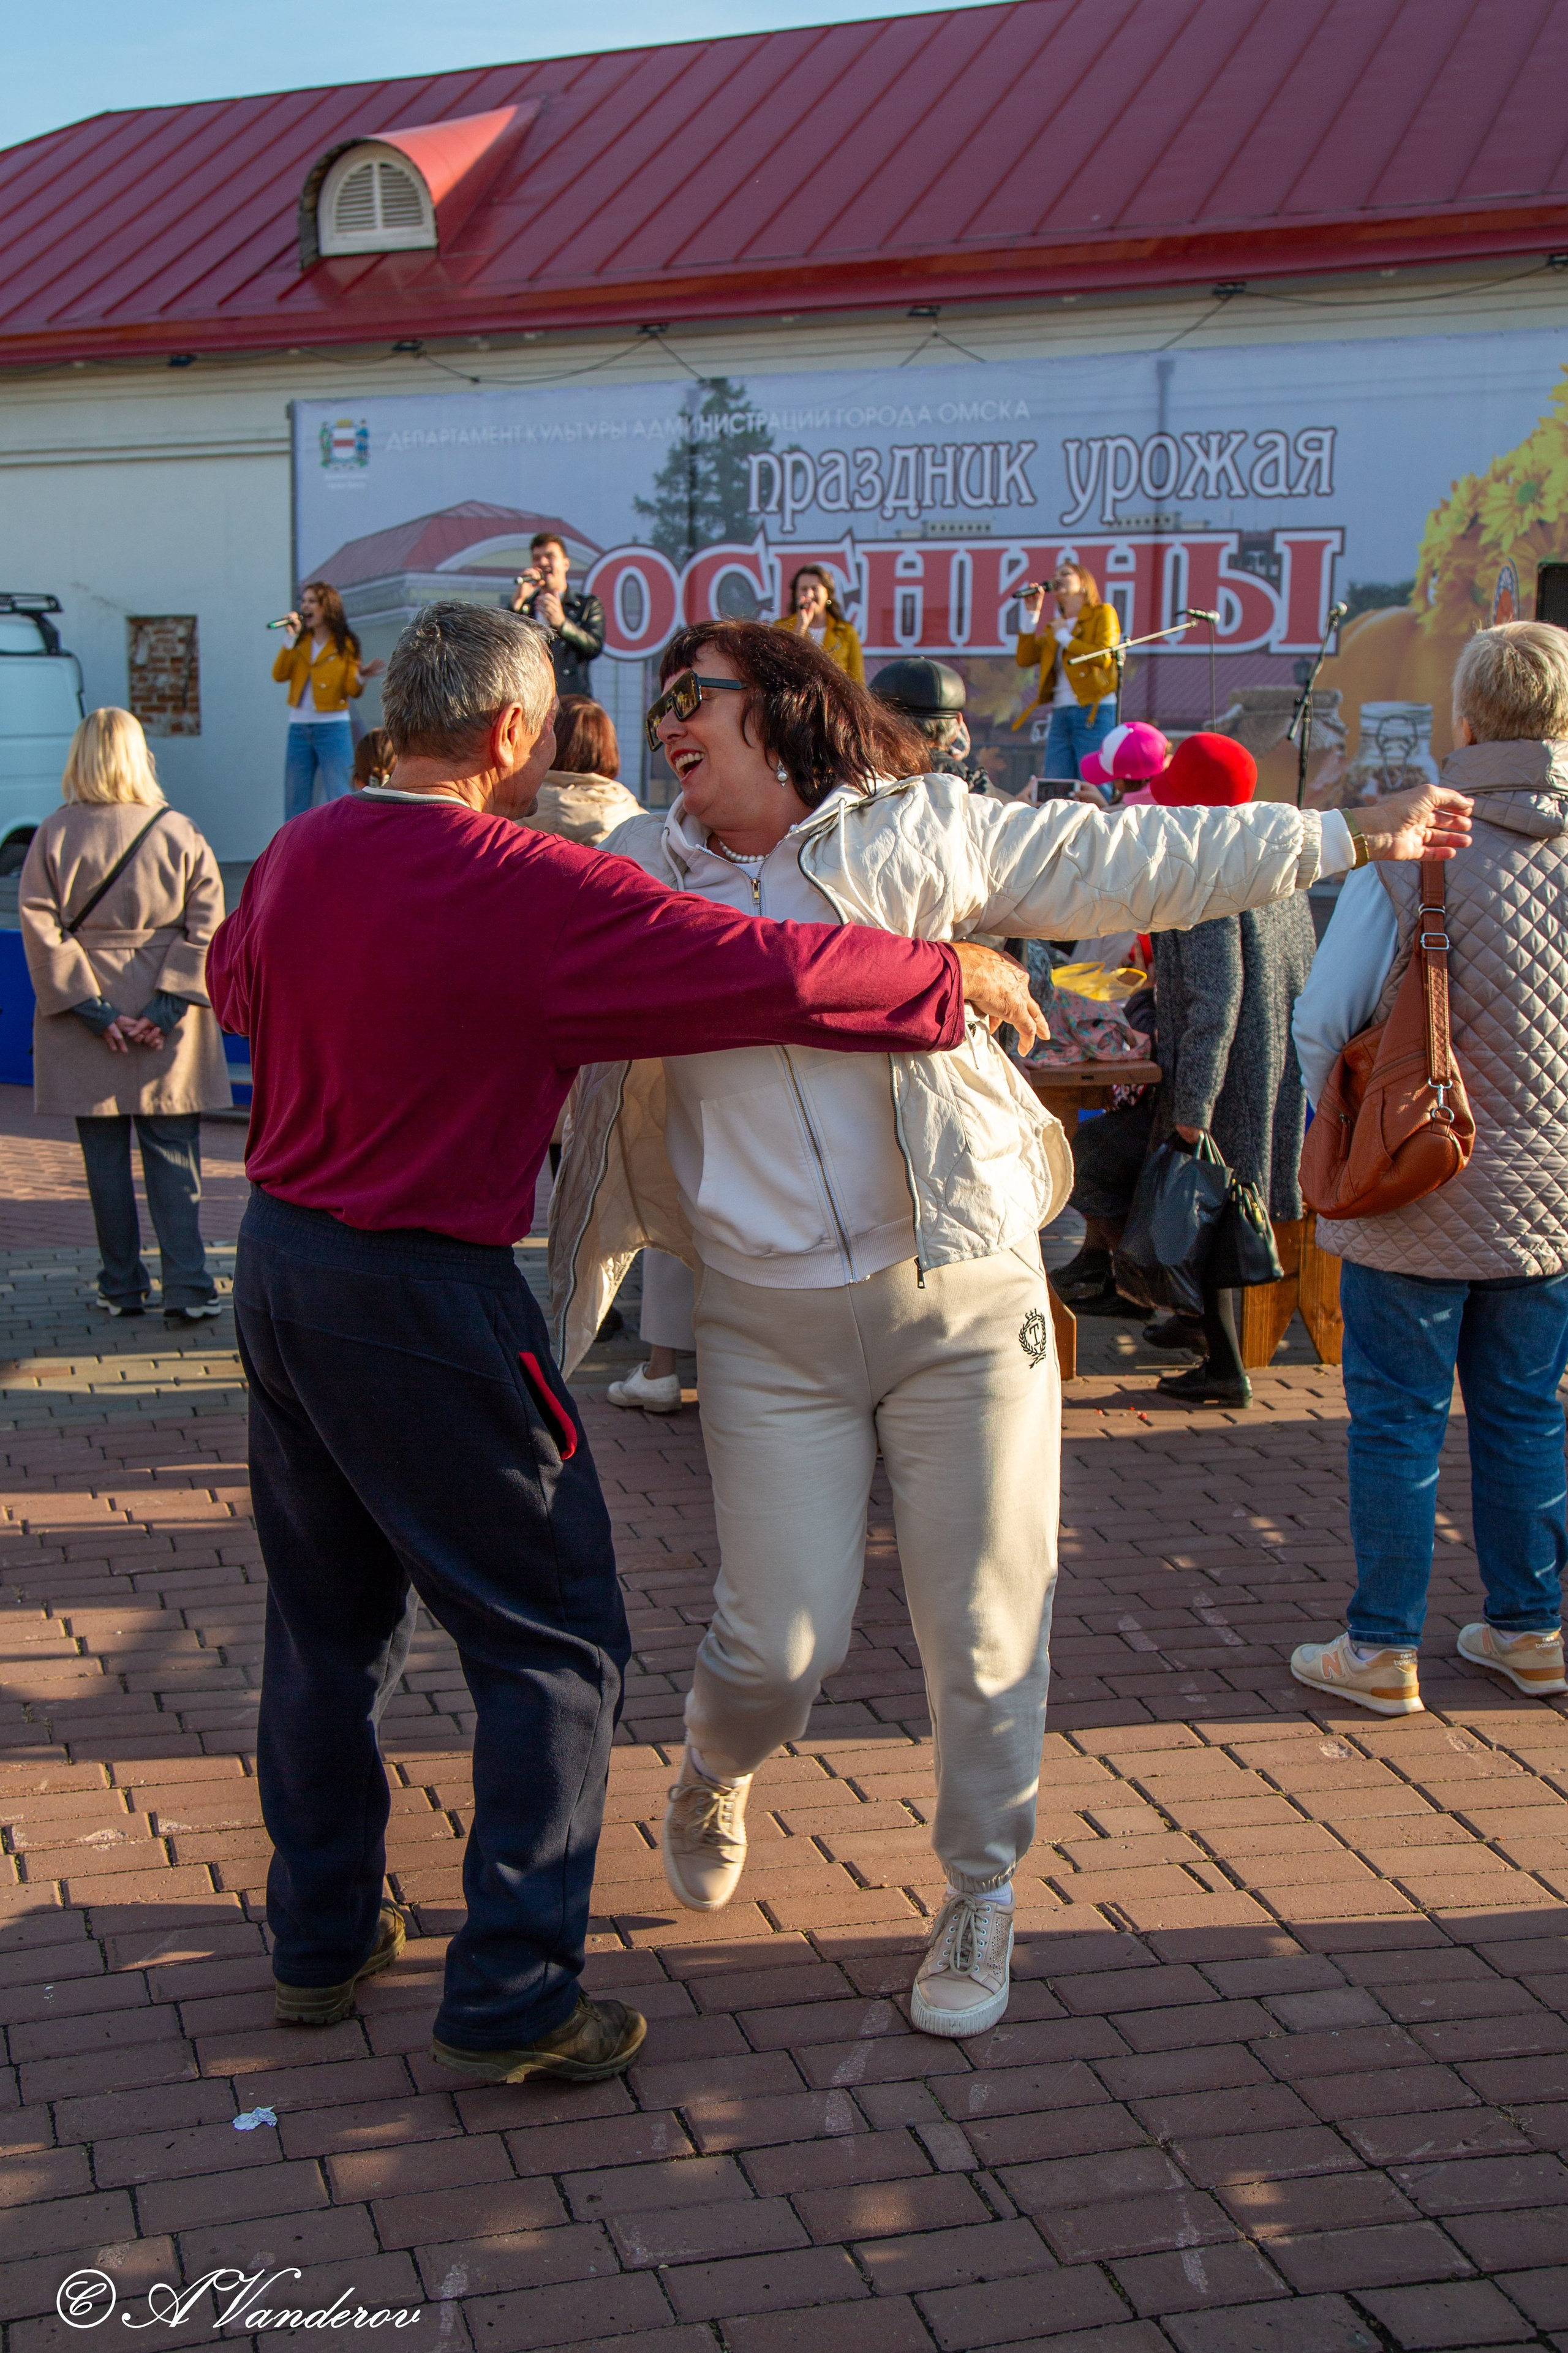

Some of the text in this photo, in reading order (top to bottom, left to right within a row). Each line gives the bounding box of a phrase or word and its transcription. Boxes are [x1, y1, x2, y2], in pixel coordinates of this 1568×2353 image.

[385, 425, 522, 453] ДЕПАРТАМЕНТ
[524, 418, 628, 445] КУЛЬТУРЫ
[837, 403, 933, 429] ГОРОДА
[938, 398, 1031, 424] ОМСКА
[1058, 425, 1338, 528] урожая
[1029, 1323, 1040, 1346] T
[1321, 1650, 1344, 1680] N
